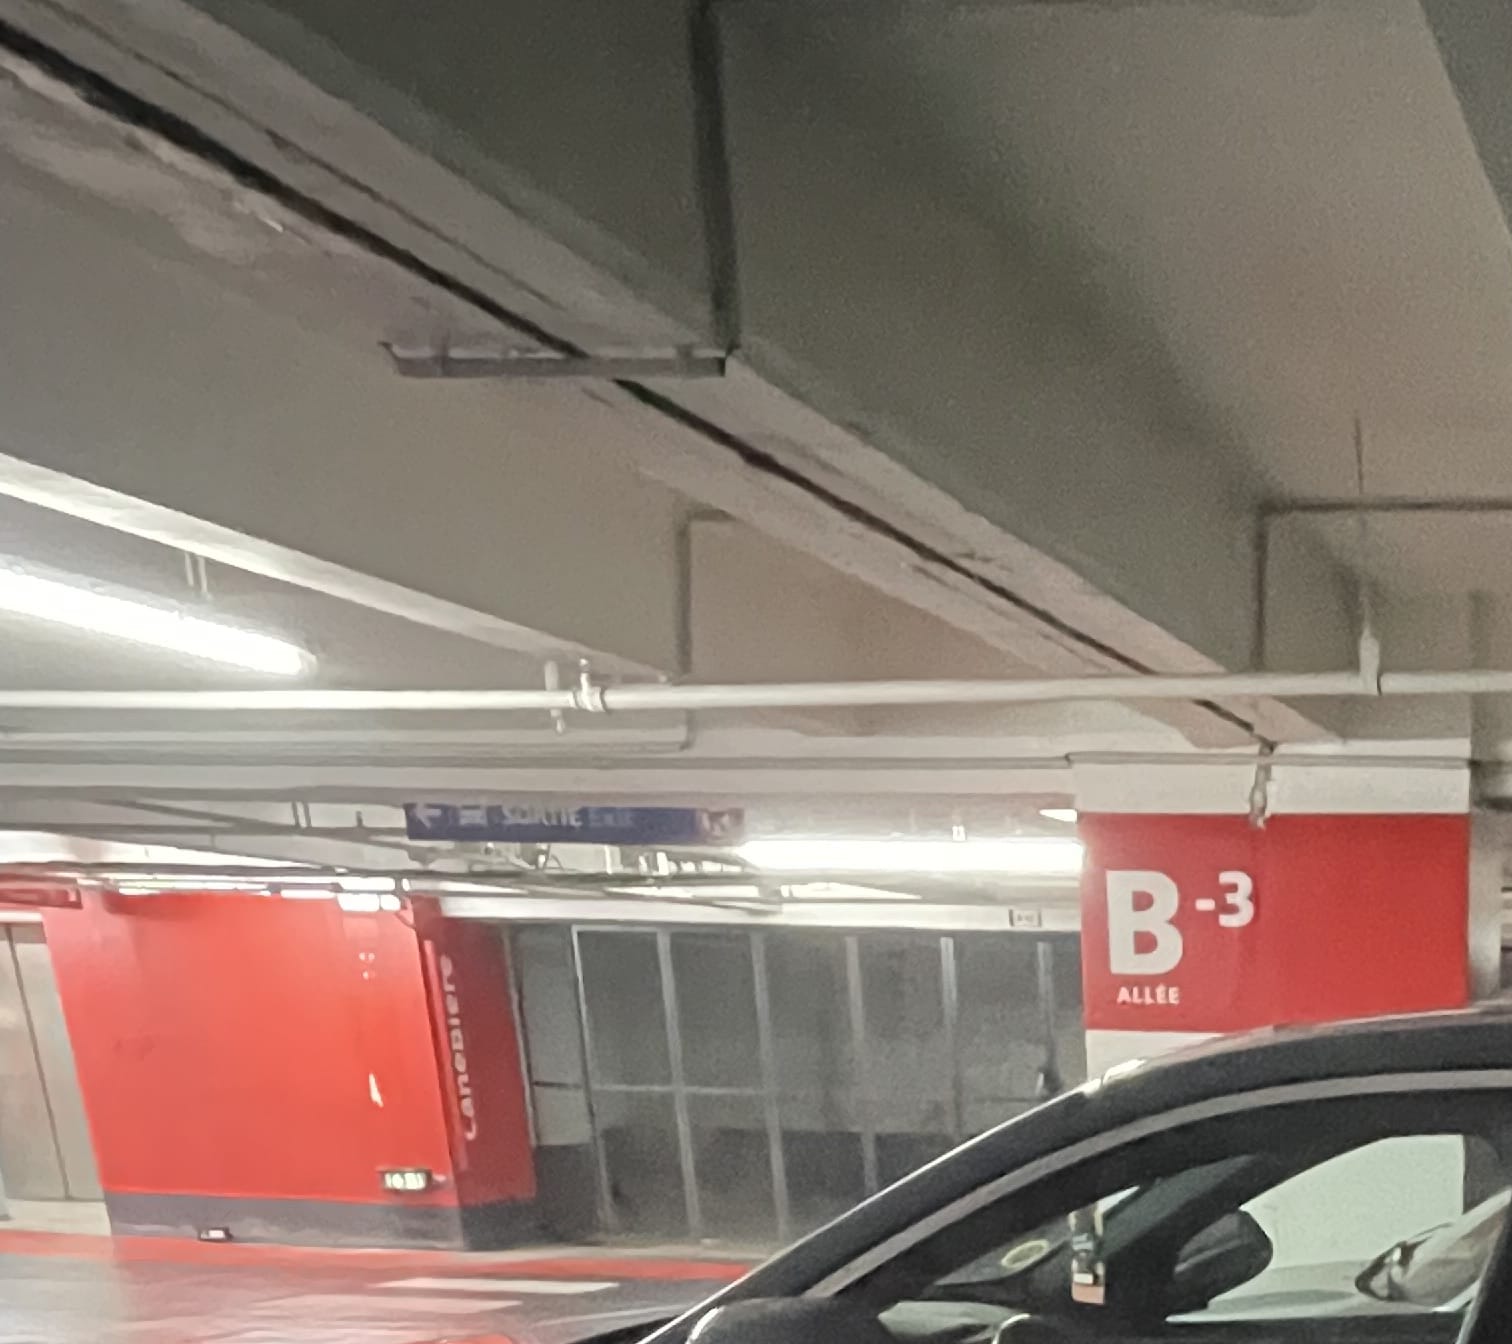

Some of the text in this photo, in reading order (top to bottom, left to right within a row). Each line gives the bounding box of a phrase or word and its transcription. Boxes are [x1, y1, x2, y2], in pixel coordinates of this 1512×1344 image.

[1105, 869, 1255, 975] B -3
[1116, 983, 1180, 1006] ALLÉE
